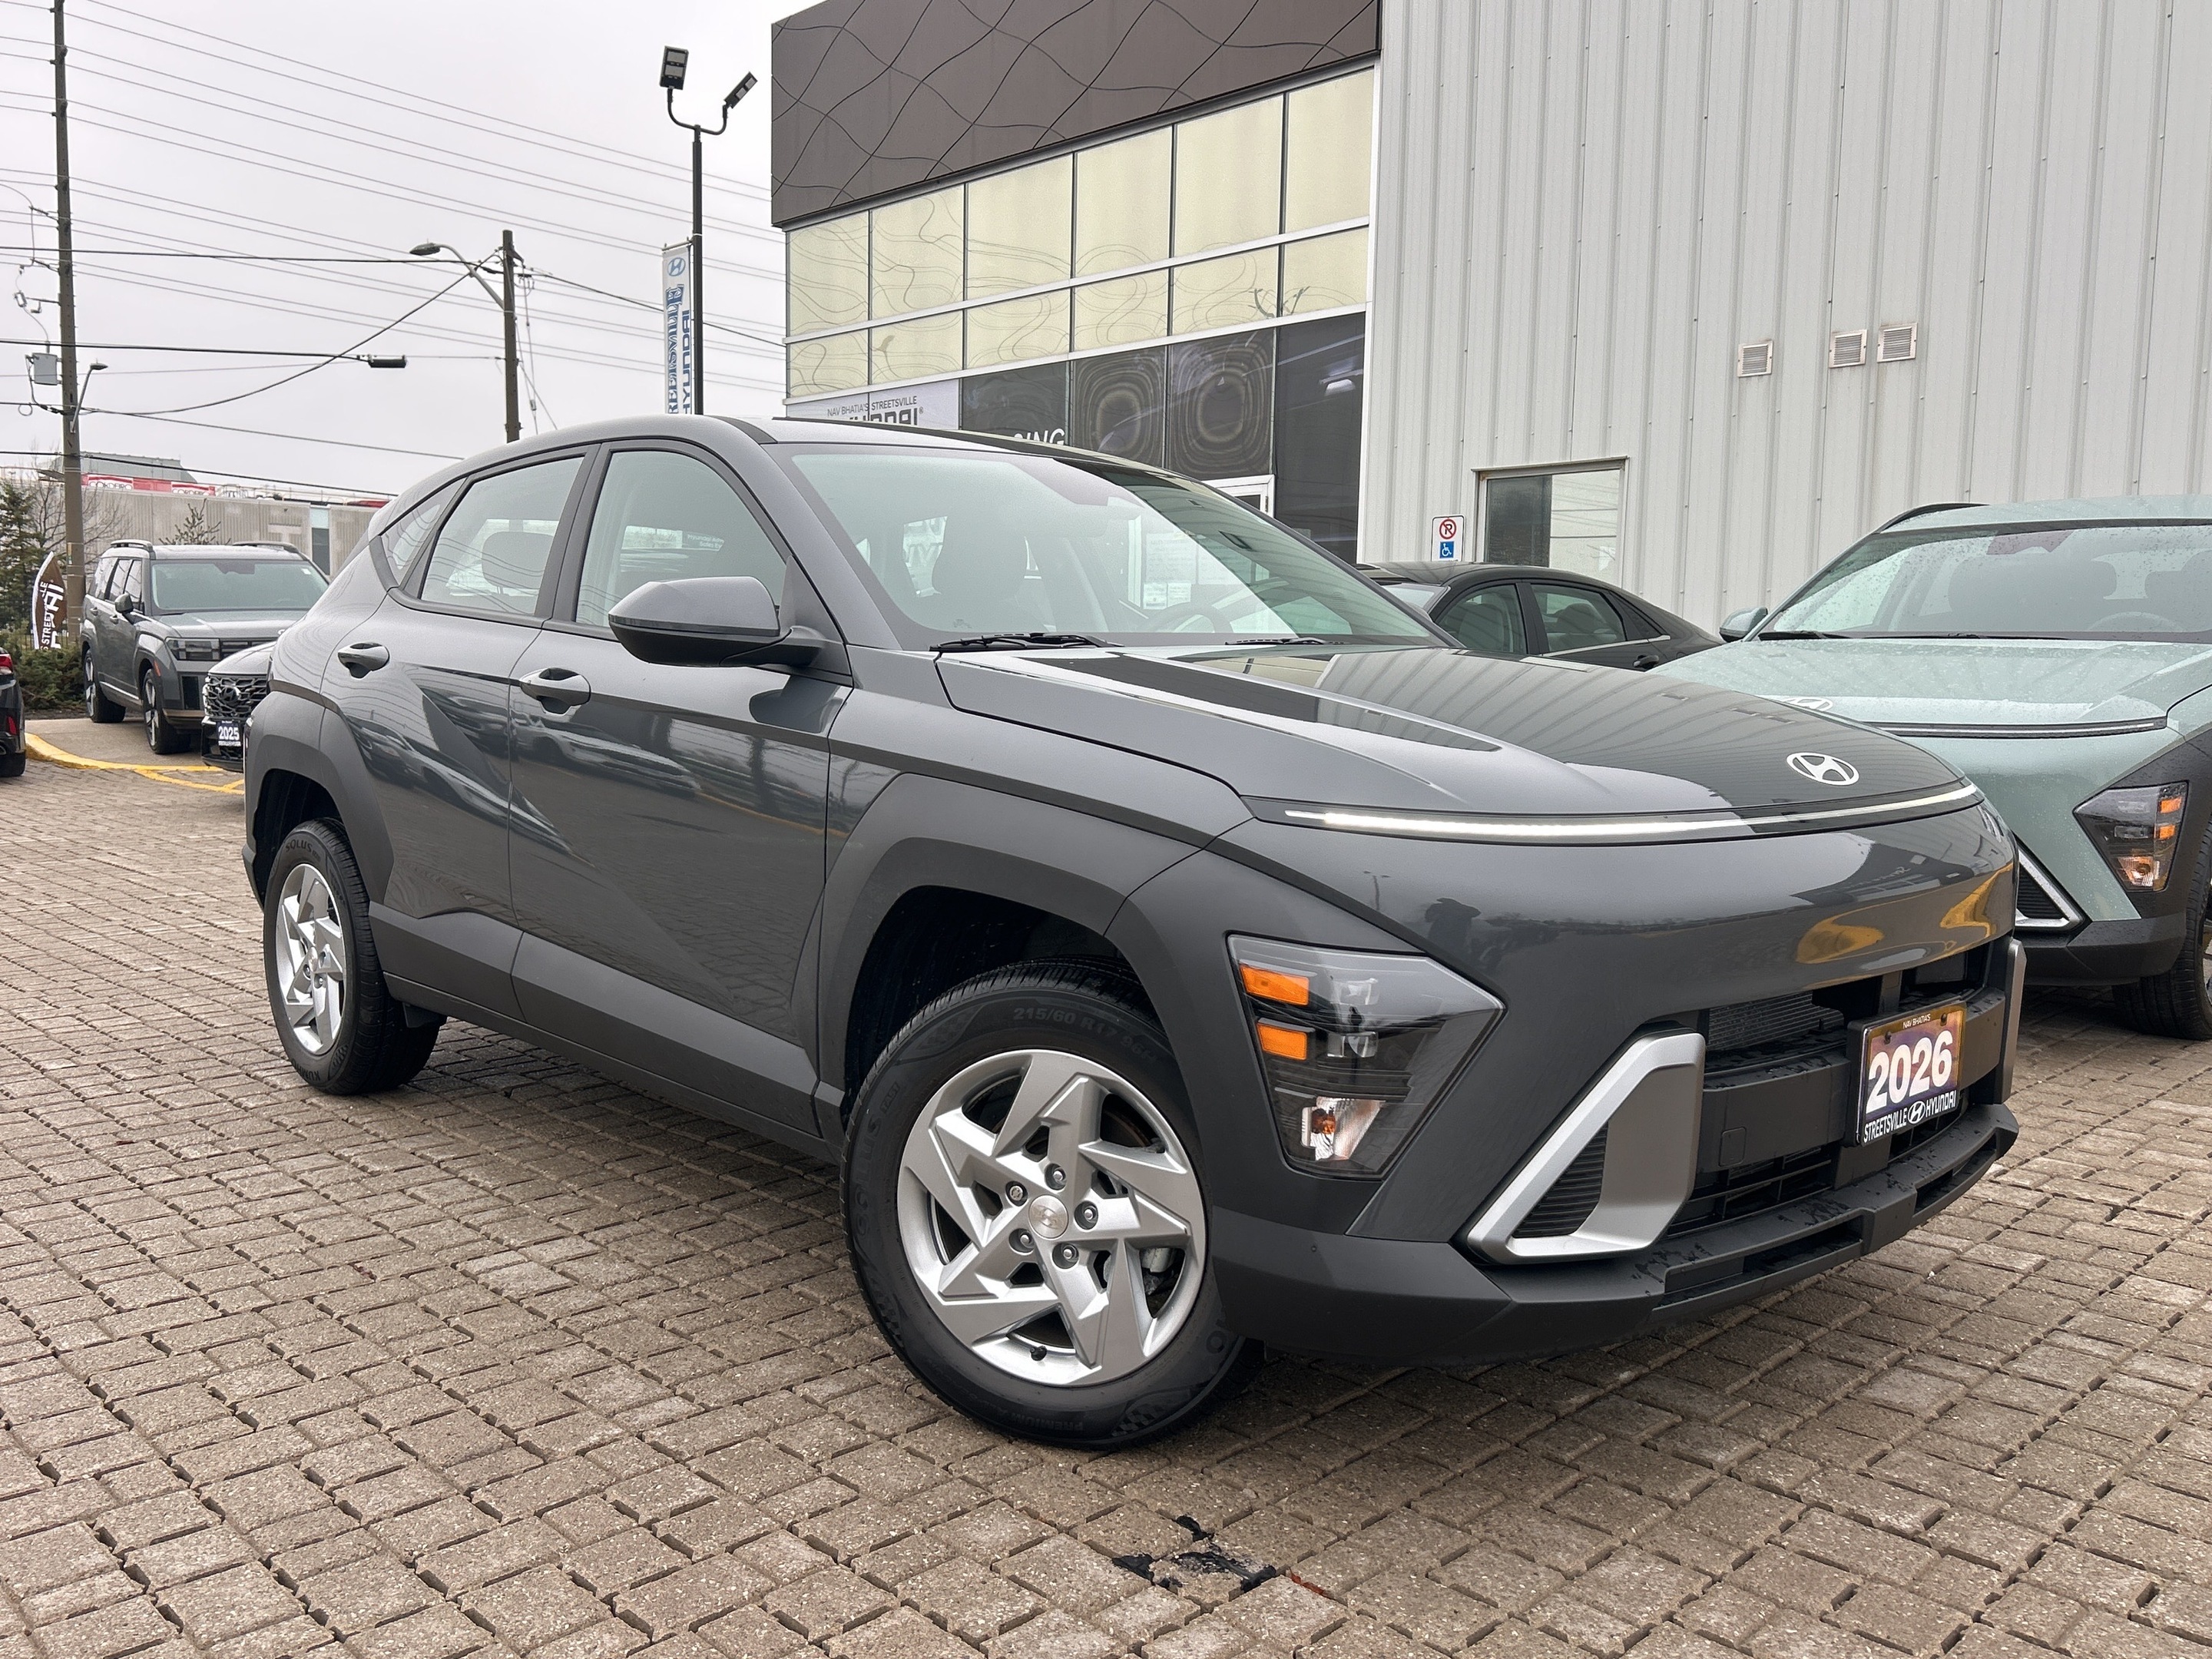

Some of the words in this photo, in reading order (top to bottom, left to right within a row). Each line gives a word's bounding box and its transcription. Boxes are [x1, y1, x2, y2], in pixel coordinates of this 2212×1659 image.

[666, 284, 684, 414] REETSVILLE
[827, 406, 841, 417] NAV
[842, 403, 869, 415] BHATIA'S
[871, 396, 918, 411] STREETSVILLE
[218, 726, 240, 740] 2025
[285, 839, 313, 853] SOLUS
[1013, 1007, 1075, 1025] 215/60
[1866, 1030, 1953, 1114] 2026
[1863, 1108, 1908, 1143] STREETSVILLE
[1926, 1090, 1957, 1118] HYUNDAI
